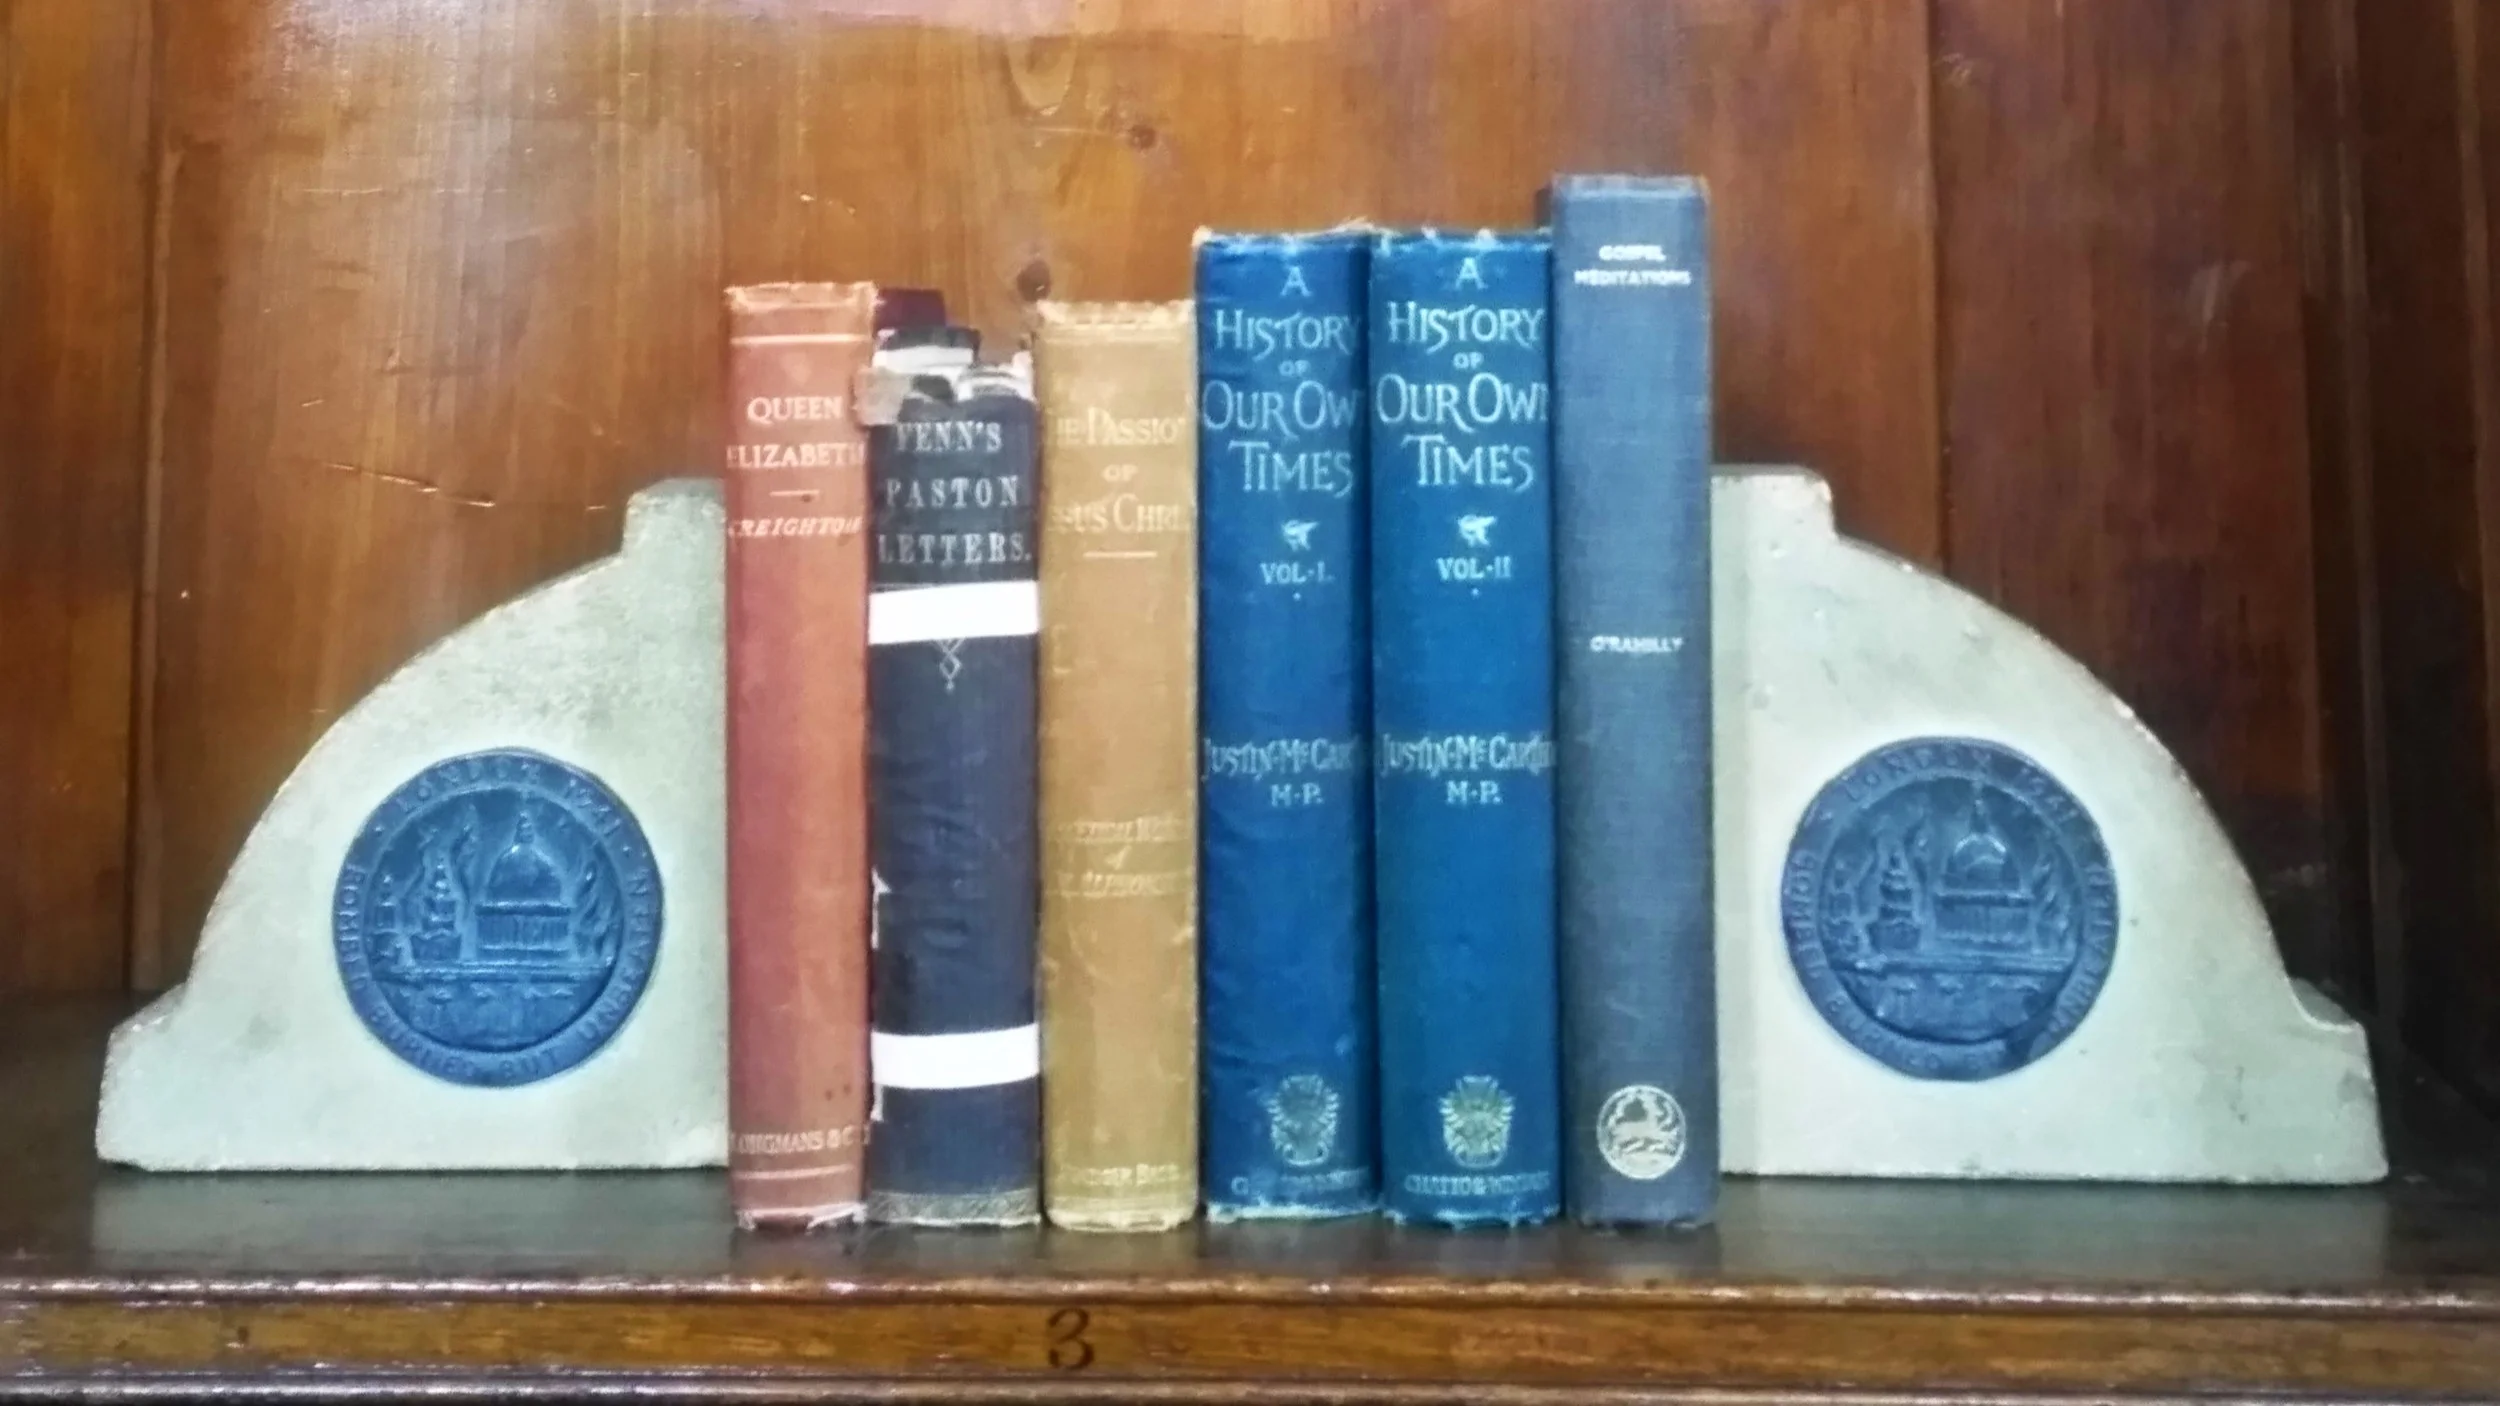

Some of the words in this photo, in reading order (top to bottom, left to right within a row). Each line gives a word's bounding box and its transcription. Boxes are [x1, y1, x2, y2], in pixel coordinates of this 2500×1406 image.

[1281, 265, 1312, 297] A
[1454, 257, 1487, 290] A
[1387, 301, 1546, 354] HISTORY
[747, 395, 843, 425] QUEEN
[1202, 379, 1298, 441] OUR
[1376, 373, 1475, 433] OUR
[1227, 440, 1354, 499] TIMES
[1401, 433, 1535, 493] TIMES
[886, 475, 1019, 508] PASTON
[877, 533, 1033, 566] LETTERS.
[1048, 1308, 1095, 1370] 3
